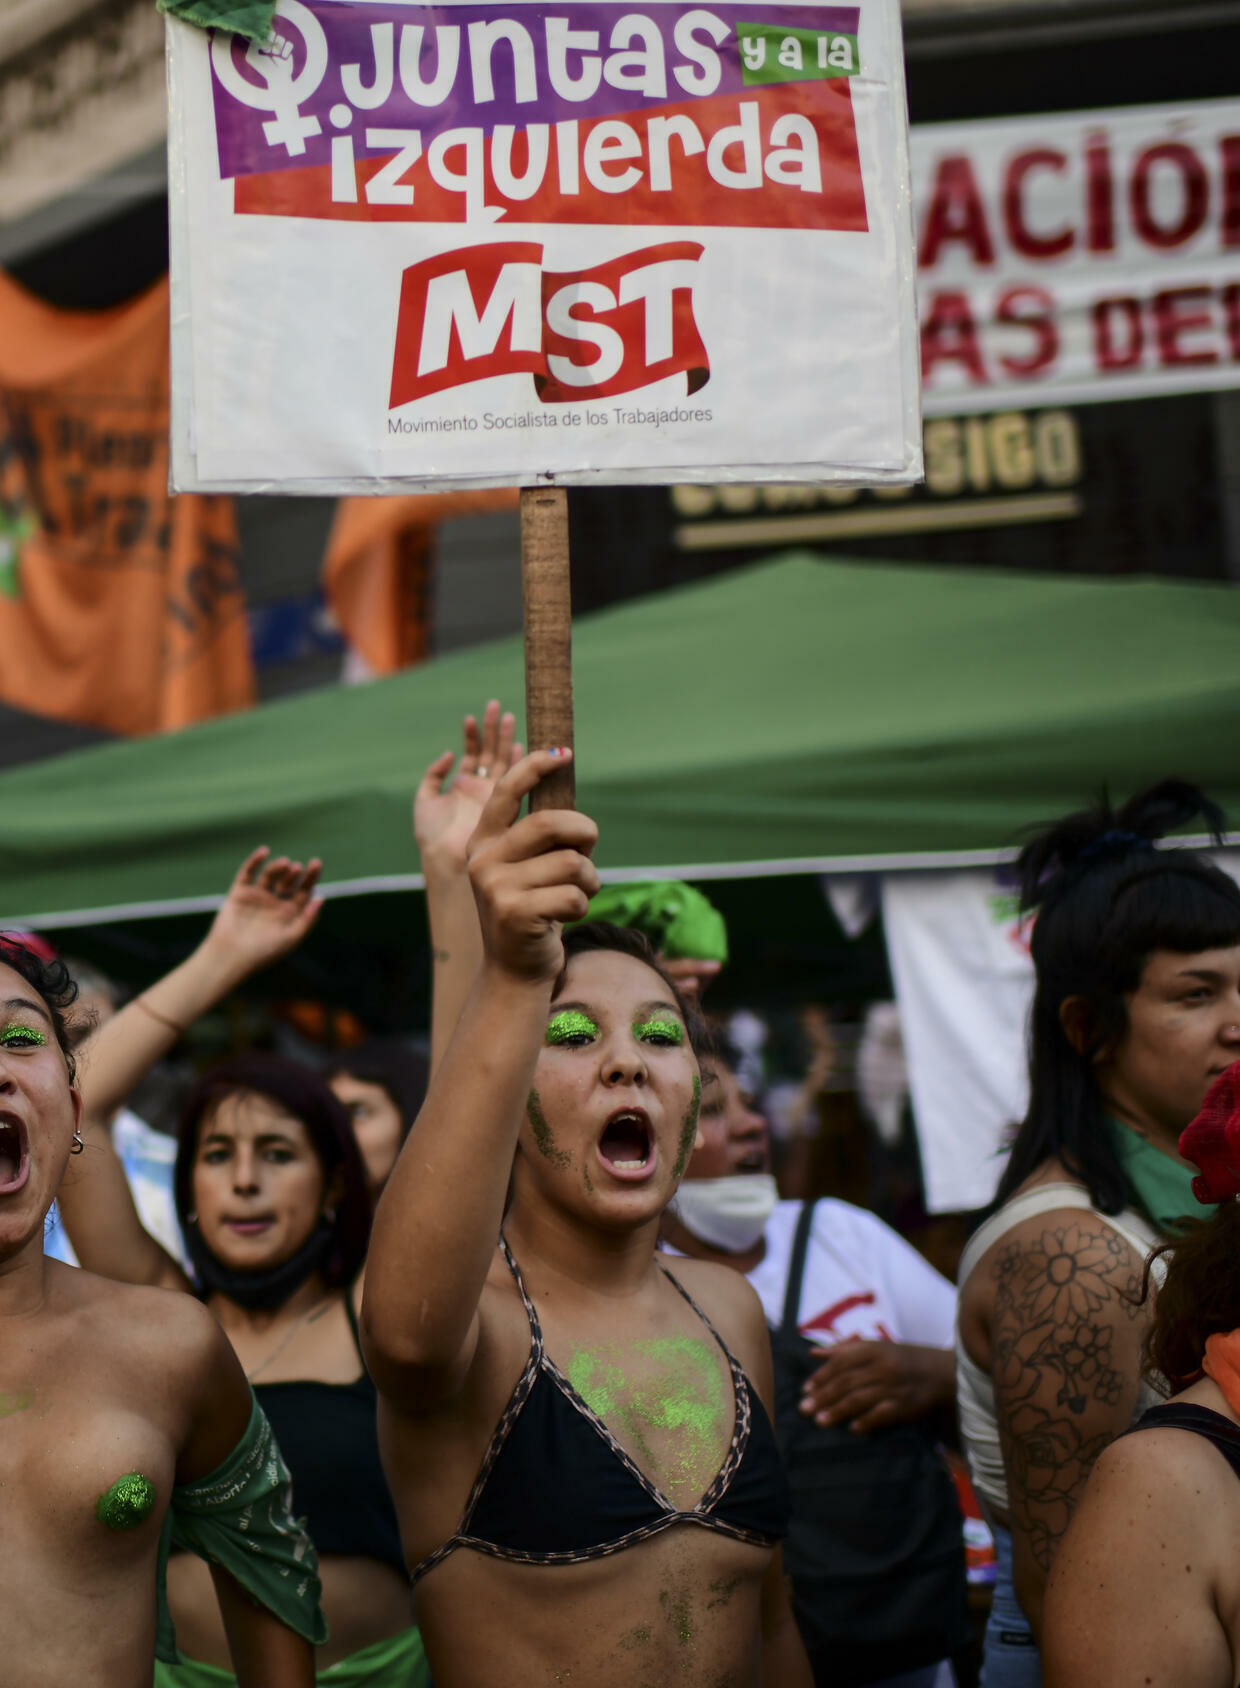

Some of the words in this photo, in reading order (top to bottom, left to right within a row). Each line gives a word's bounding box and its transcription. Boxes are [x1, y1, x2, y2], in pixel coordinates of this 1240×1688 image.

[742, 36, 766, 71] y
[778, 36, 803, 71] a
[817, 36, 853, 70] la
[417, 259, 700, 387] MST
[388, 415, 479, 435] Movimiento
[483, 411, 558, 431] Socialista
[562, 410, 582, 427] de
[586, 409, 609, 426] los
[613, 407, 713, 429] Trabajadores
